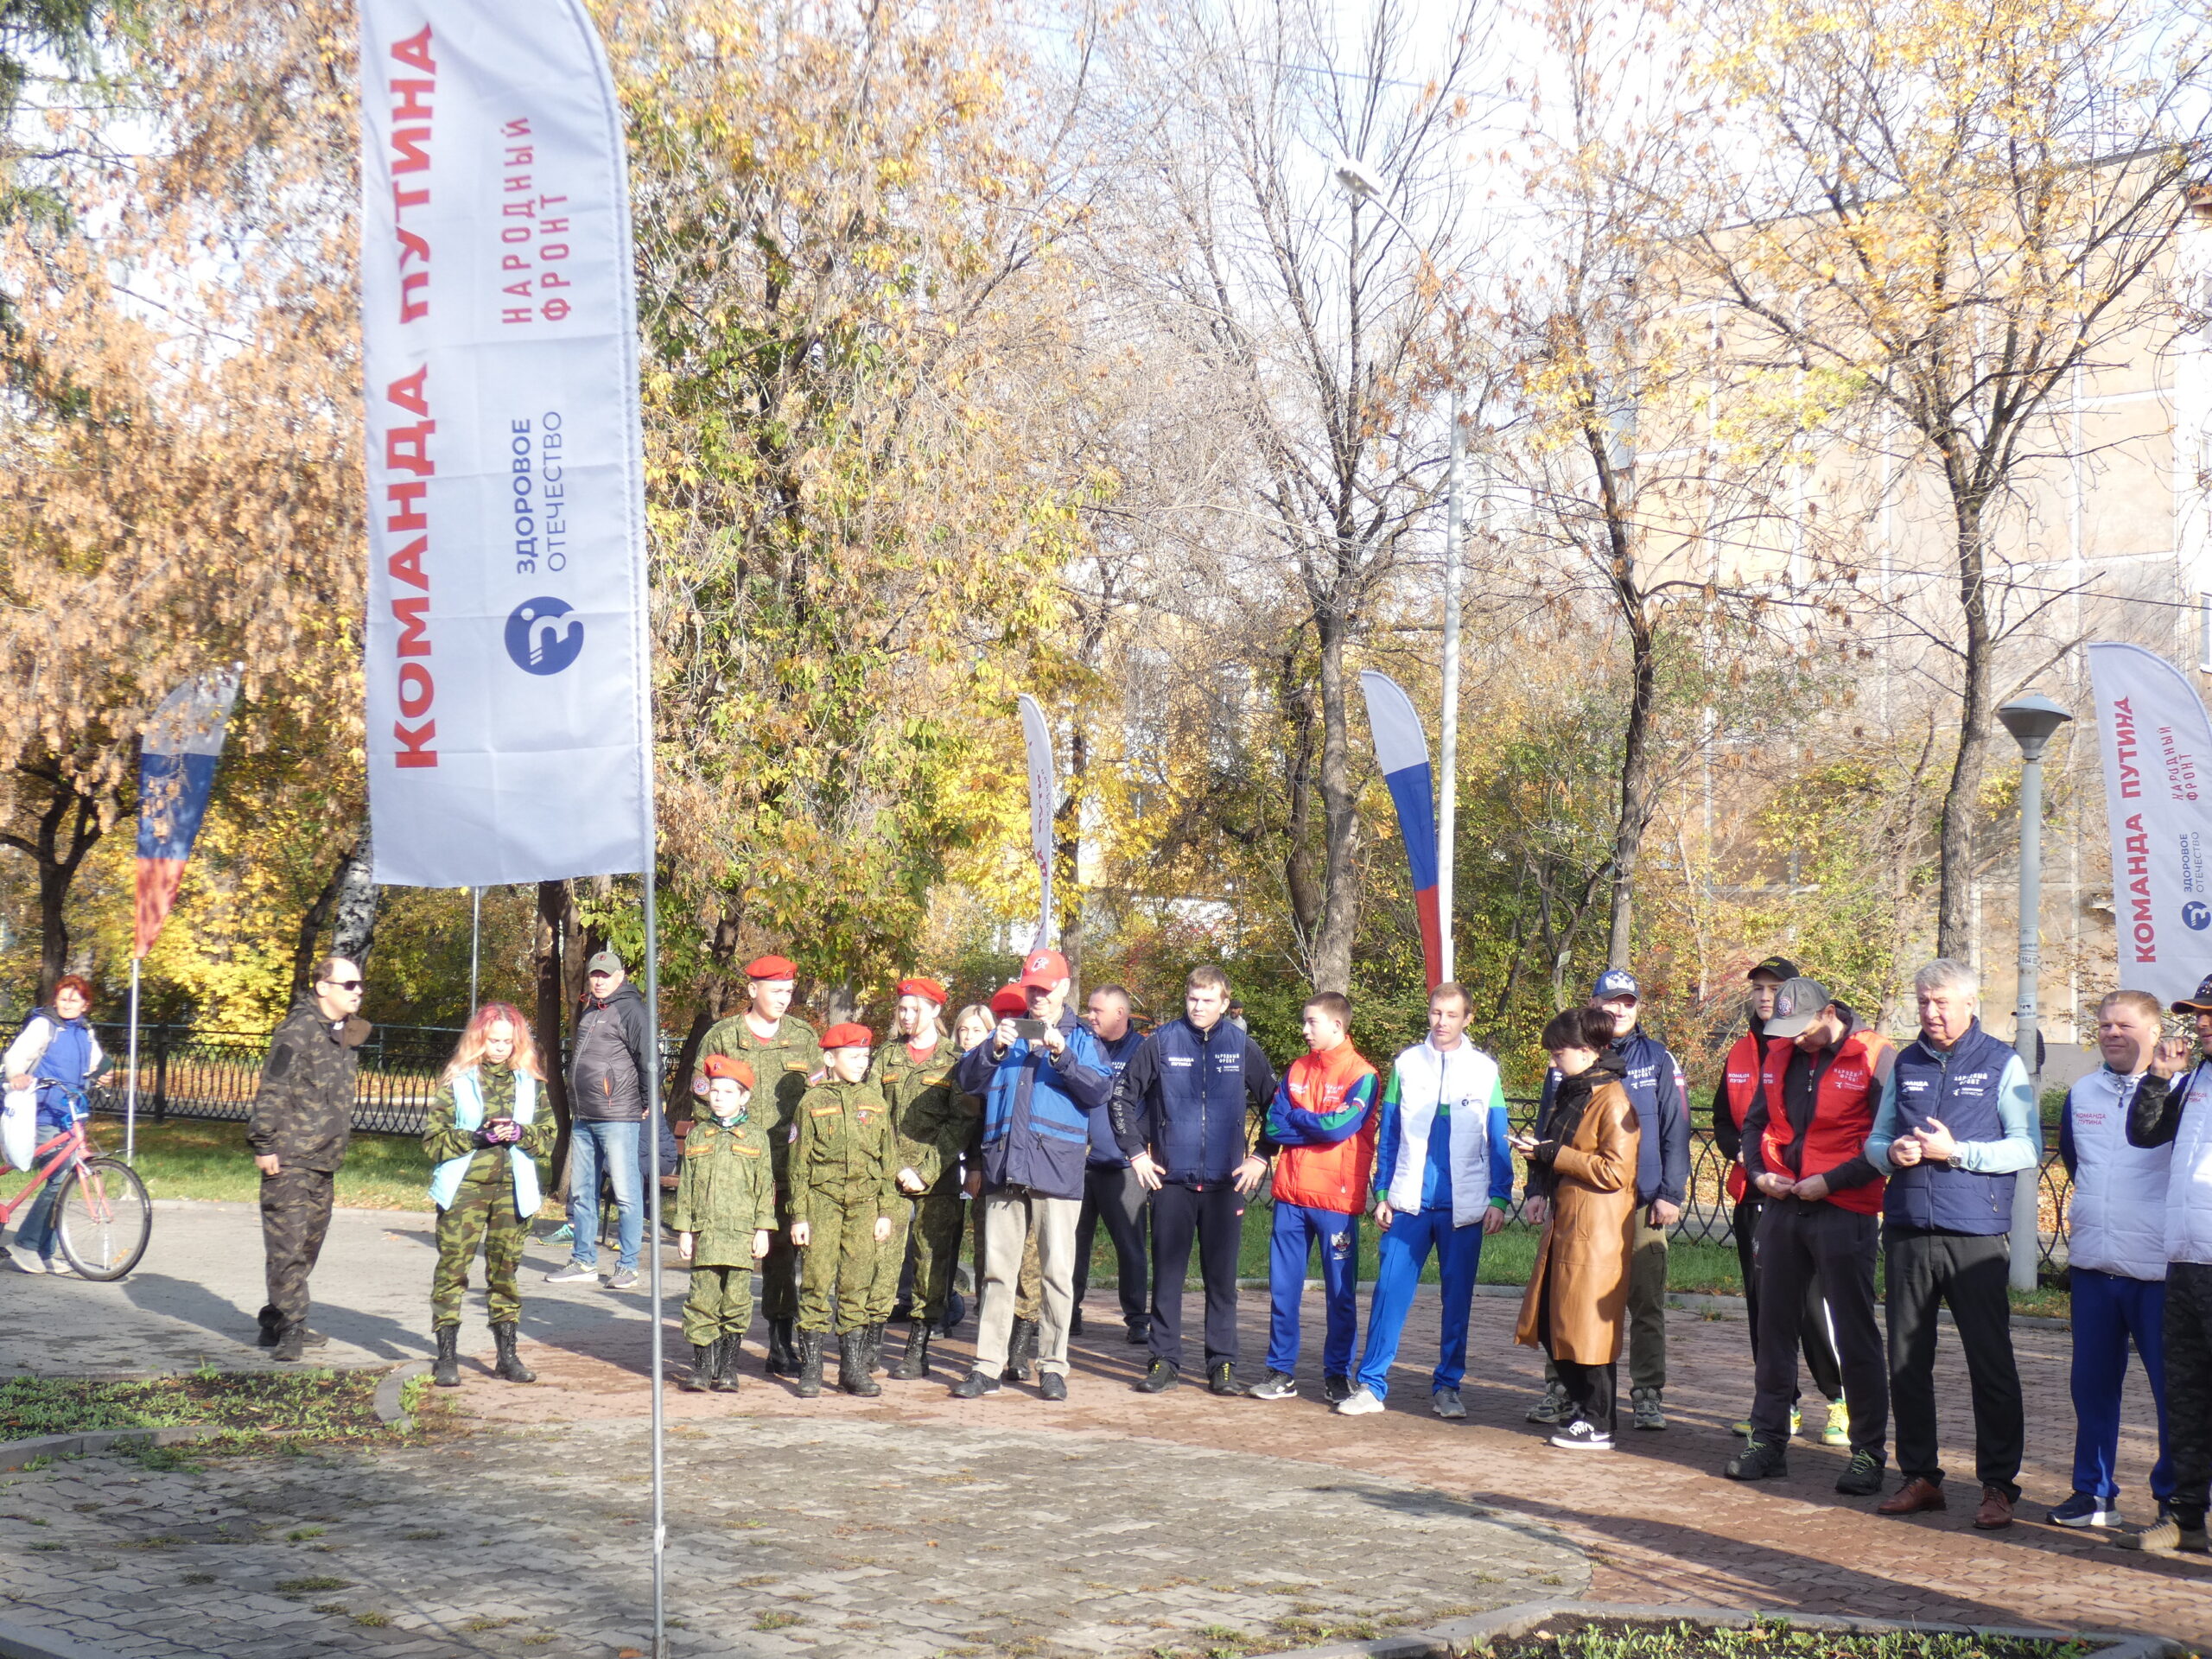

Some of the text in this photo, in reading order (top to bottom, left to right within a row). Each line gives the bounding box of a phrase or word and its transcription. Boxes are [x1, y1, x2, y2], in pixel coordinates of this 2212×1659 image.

[500, 117, 535, 324] НАРОДНЫЙ
[539, 193, 570, 321] ФРОНТ
[386, 21, 438, 768] КОМАНДА ПУТИНА
[512, 417, 538, 574] ЗДОРОВОЕ
[543, 410, 567, 572] ОТЕЧЕСТВО
[2113, 696, 2156, 963] КОМАНДА ПУТИНА
[2157, 726, 2184, 800] НАРОДНЫЙ
[2178, 753, 2198, 800] ФРОНТ
[2180, 834, 2193, 893] ЗДОРОВОЕ
[2191, 831, 2204, 893] ОТЕЧЕСТВО
